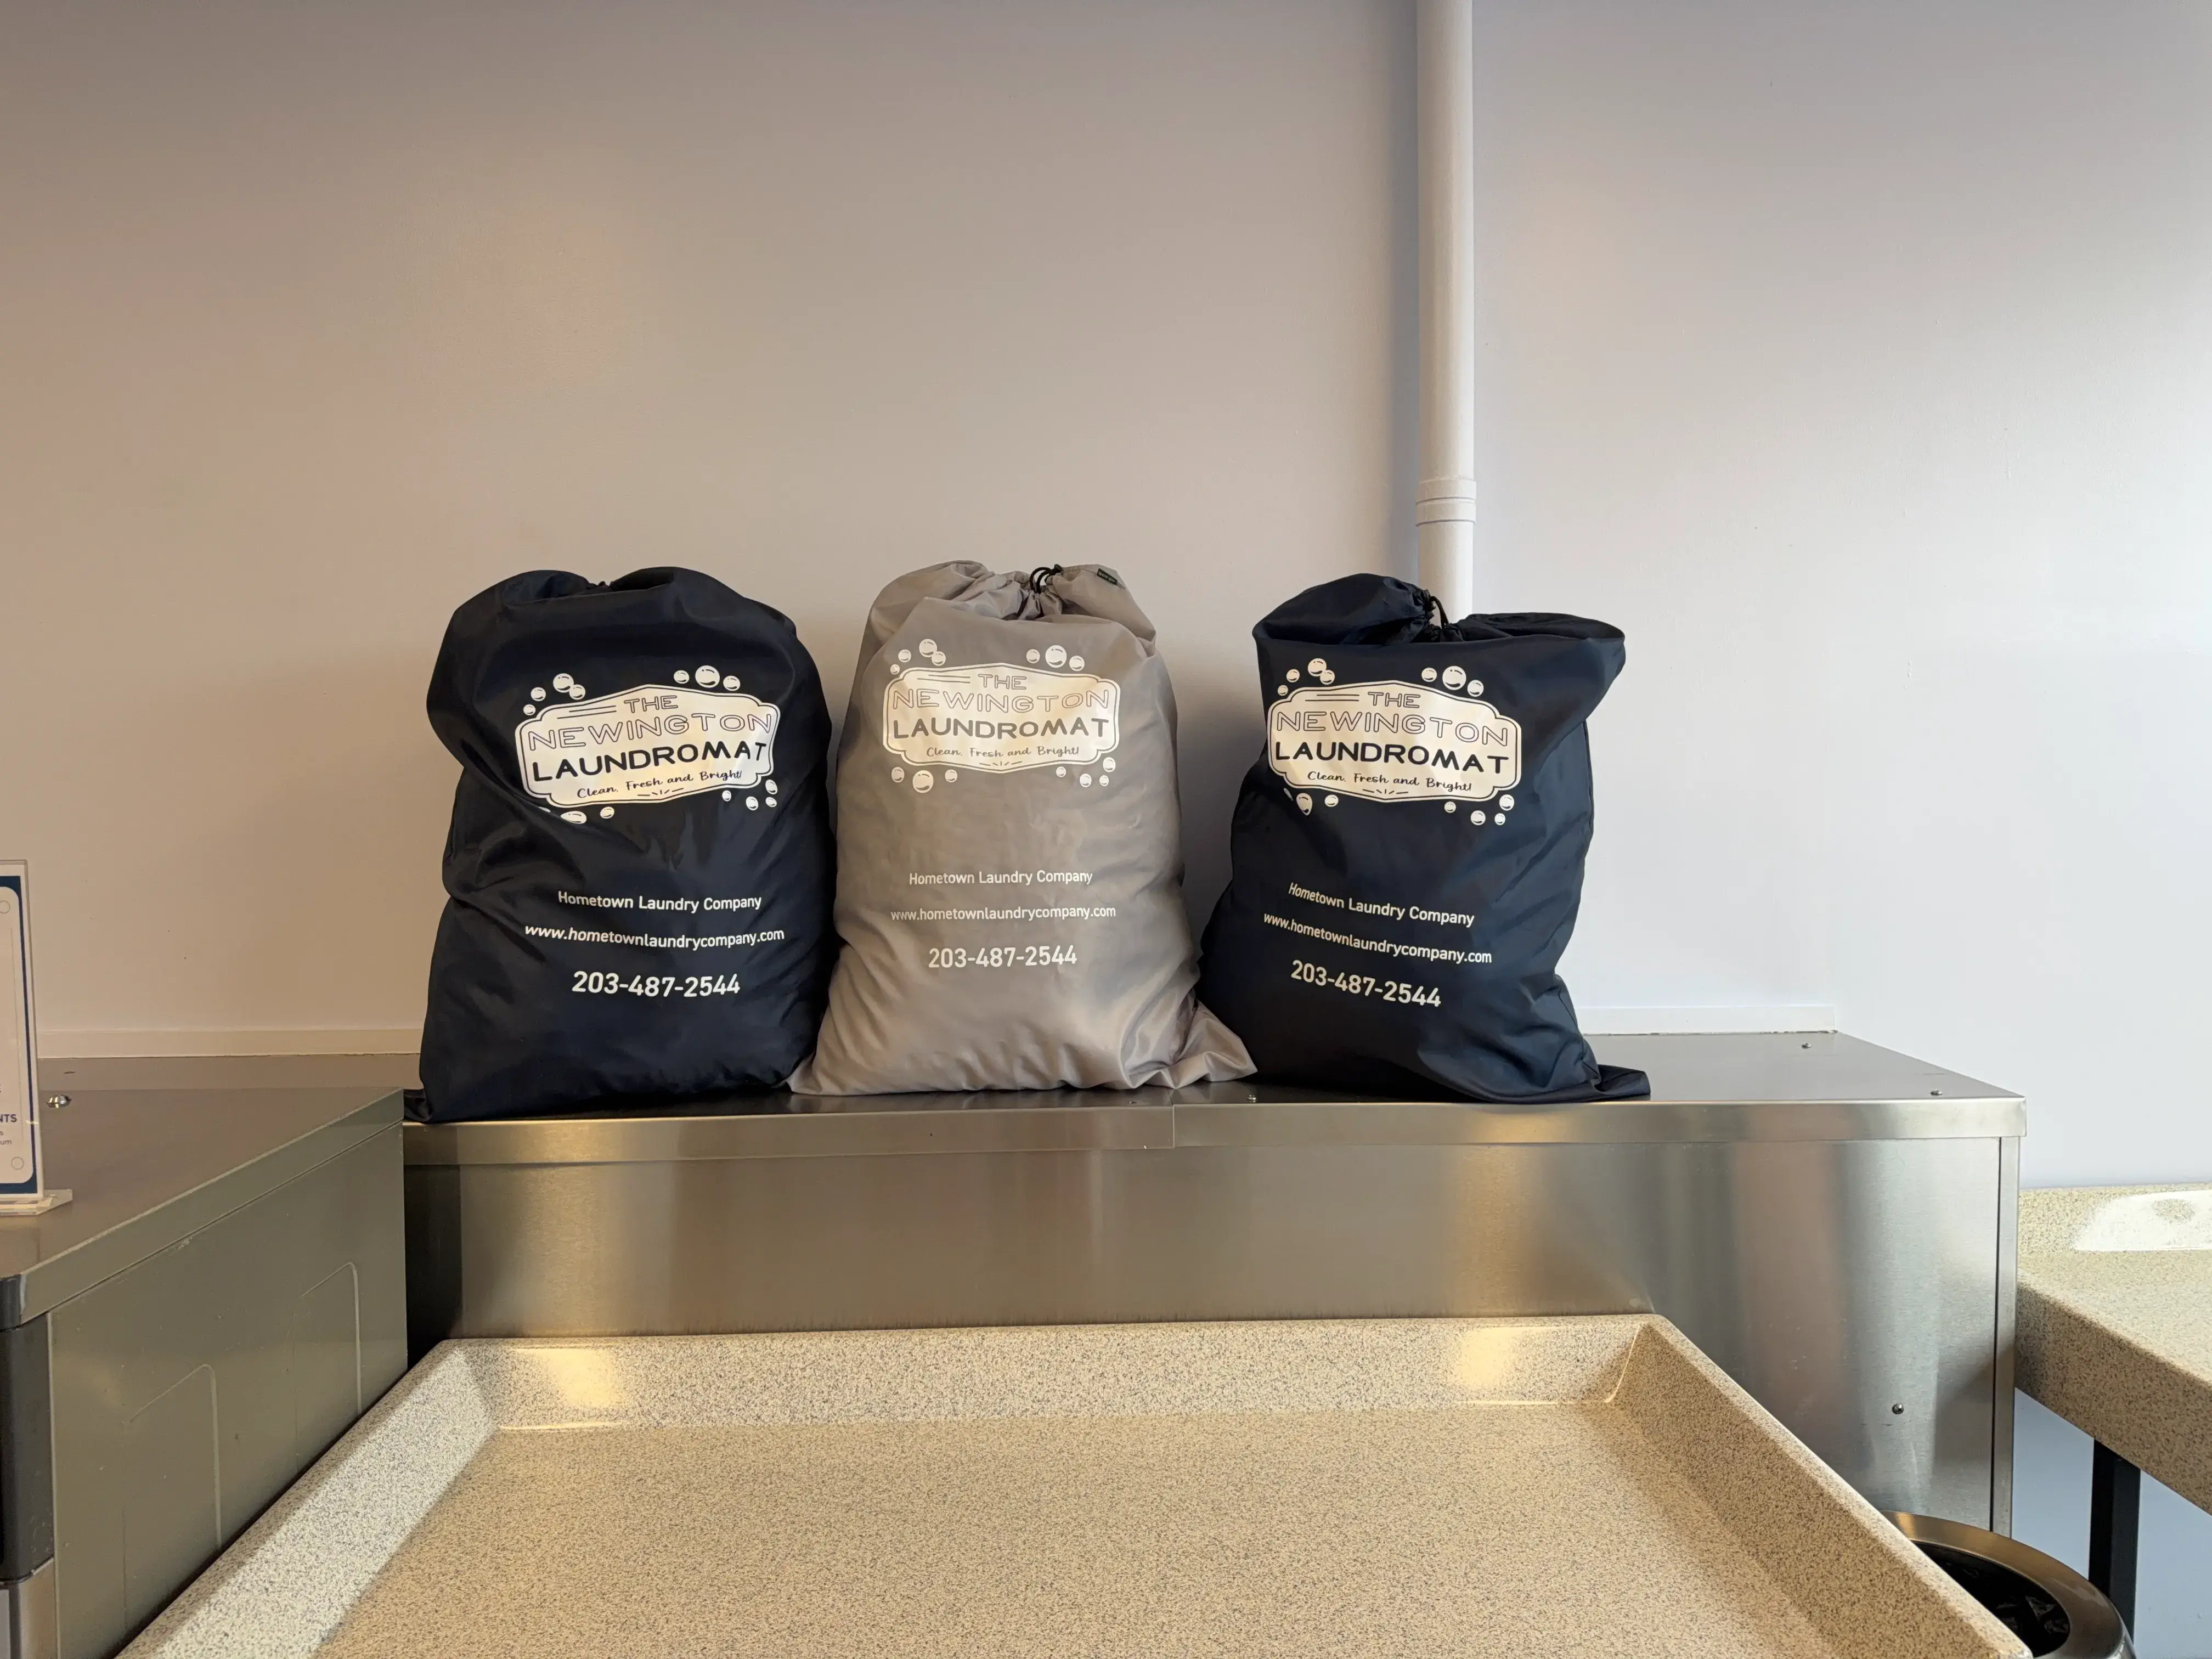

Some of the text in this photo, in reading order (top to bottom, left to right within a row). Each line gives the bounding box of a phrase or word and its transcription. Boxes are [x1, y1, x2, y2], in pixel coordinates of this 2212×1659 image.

[978, 674, 1027, 690] THE
[624, 695, 678, 713] THE
[893, 689, 1109, 713] NEWINGTON
[1368, 692, 1420, 708] THE
[528, 713, 771, 751] NEWINGTON
[893, 717, 1109, 740] LAUNDROMAT
[1277, 712, 1508, 746] NEWINGTON
[533, 741, 766, 782] LAUNDROMAT
[969, 747, 1003, 757] Fresh
[1007, 747, 1031, 756] and
[1036, 746, 1079, 757] Bright!
[1276, 742, 1509, 774] LAUNDROMAT
[625, 778, 663, 791] Fresh
[667, 774, 693, 783] and
[1353, 773, 1389, 783] Fresh
[1393, 777, 1420, 786] and
[1426, 777, 1471, 792] Bright!
[909, 870, 1092, 885] Hometown Laundry Company
[558, 890, 761, 913] Hometown Laundry Company
[1288, 882, 1475, 928] Hometown Laundry Company
[890, 906, 1116, 921] www.hometownlaundrycompany.com
[525, 926, 785, 951] www.hometownlaundrycompany.com
[1263, 913, 1492, 964] www.hometownlaundrycompany.com
[928, 945, 1077, 968] 203-487-2544
[572, 971, 740, 997] 203-487-2544
[1291, 960, 1441, 1007] 203-487-2544
